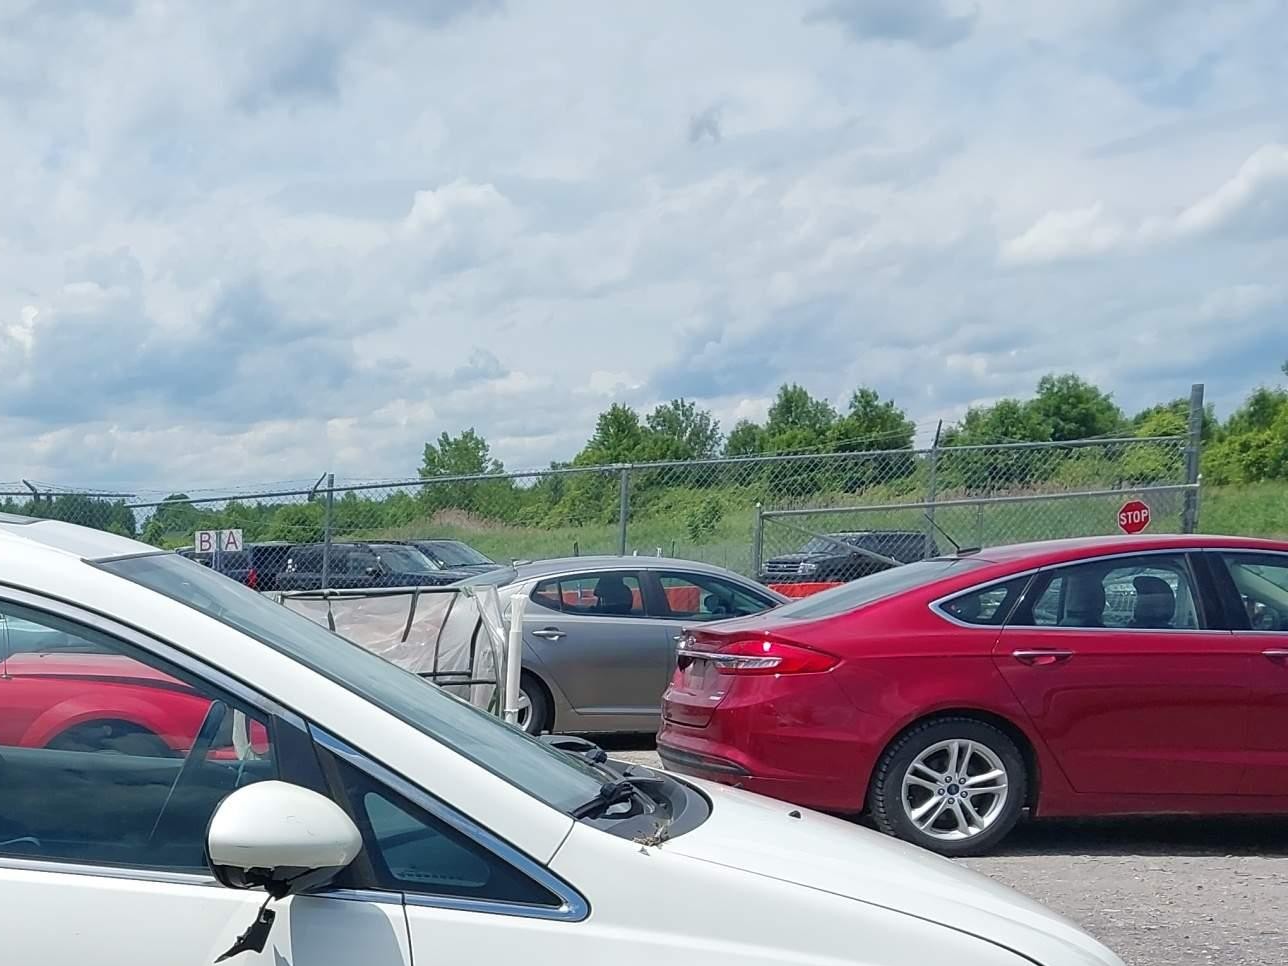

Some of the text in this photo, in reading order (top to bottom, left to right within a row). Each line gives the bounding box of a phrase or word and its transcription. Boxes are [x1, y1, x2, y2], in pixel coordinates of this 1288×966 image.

[1119, 509, 1148, 526] STOP
[199, 532, 212, 552] B
[225, 530, 239, 550] A
